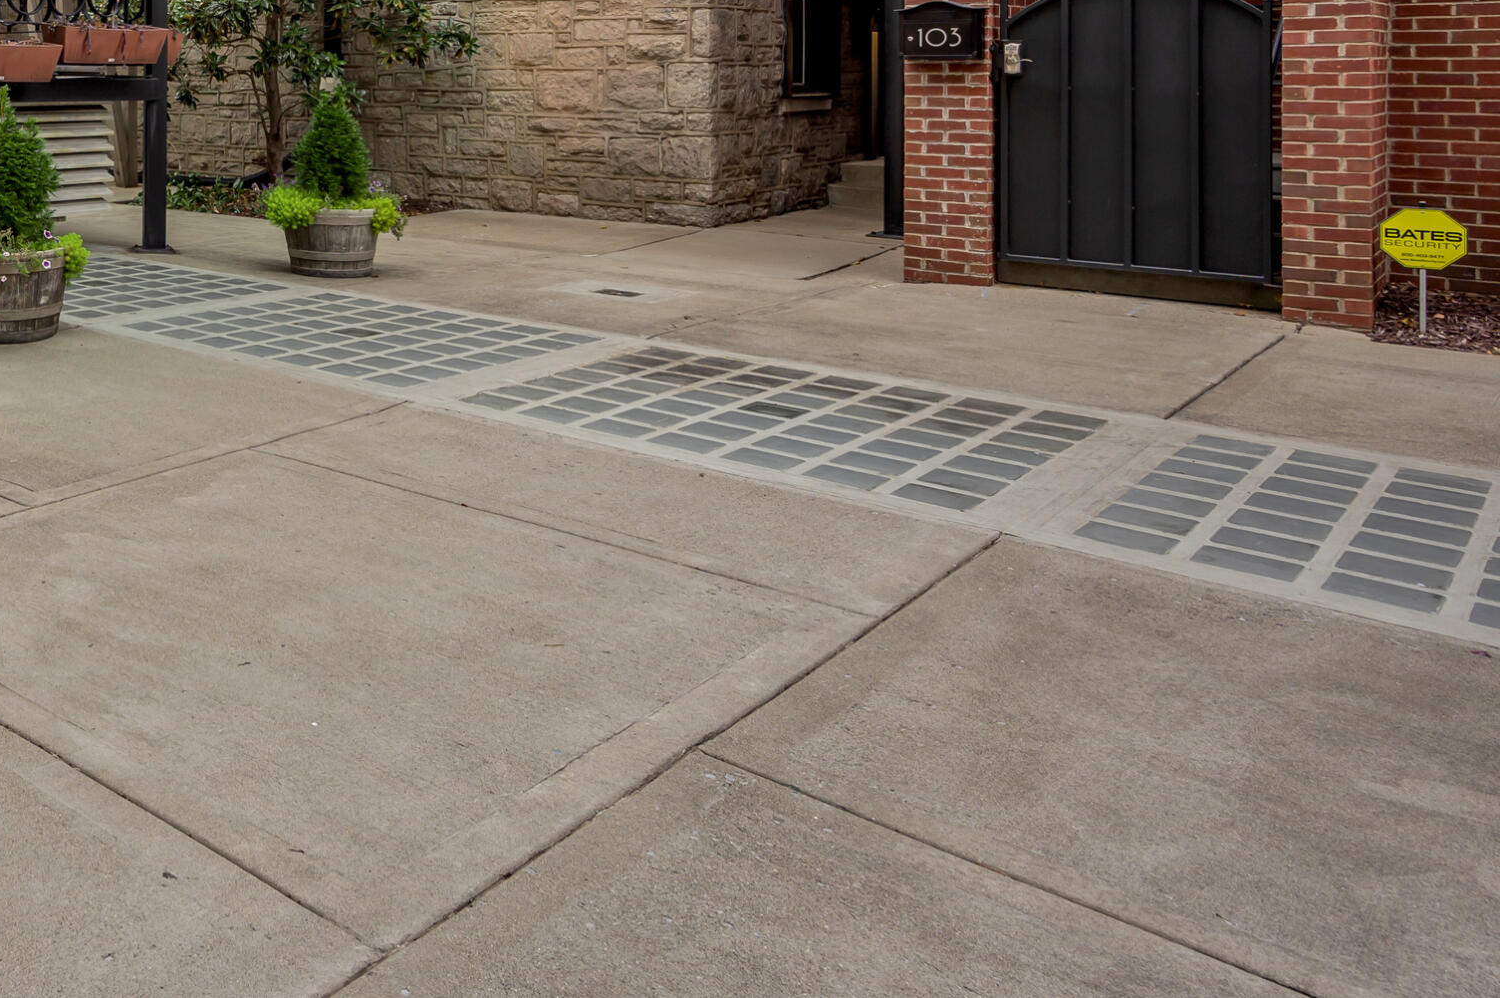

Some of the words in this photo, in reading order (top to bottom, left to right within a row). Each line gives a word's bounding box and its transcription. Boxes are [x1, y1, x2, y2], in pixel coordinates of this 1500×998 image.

[917, 27, 961, 48] 103
[1384, 228, 1463, 242] BATES
[1384, 239, 1461, 250] SECURITY
